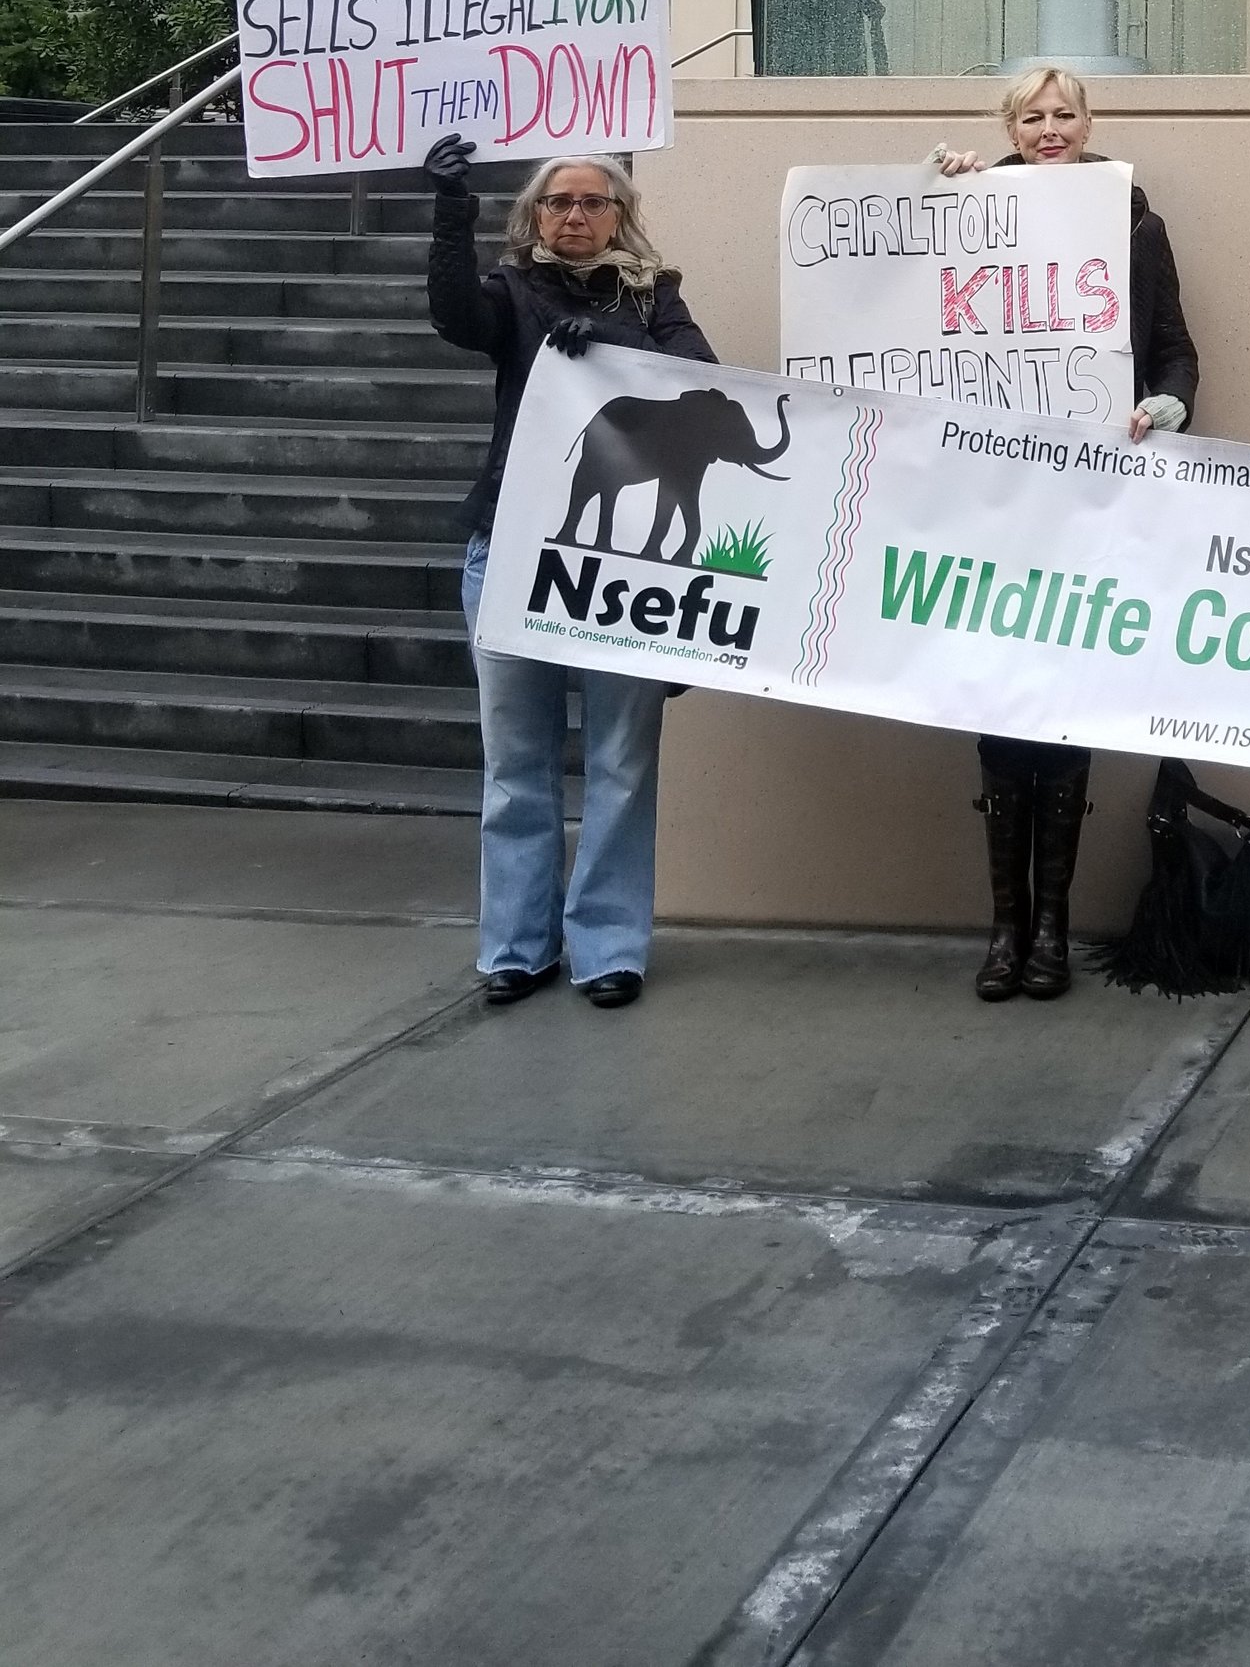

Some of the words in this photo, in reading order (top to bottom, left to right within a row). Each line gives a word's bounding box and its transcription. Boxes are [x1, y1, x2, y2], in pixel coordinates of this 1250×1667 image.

[248, 57, 419, 163] SHUT
[411, 79, 501, 127] THEM
[488, 42, 657, 146] DOWN
[788, 192, 1019, 268] CARLTON
[941, 258, 1120, 336] KILLS
[786, 345, 1113, 424] PHANTS
[941, 420, 1069, 472] Protecting
[1074, 441, 1168, 479] Africa's
[524, 617, 567, 636] Wildlife
[569, 626, 646, 651] Conservation
[527, 548, 761, 651] Nsefu
[881, 545, 1152, 656] Wildlife
